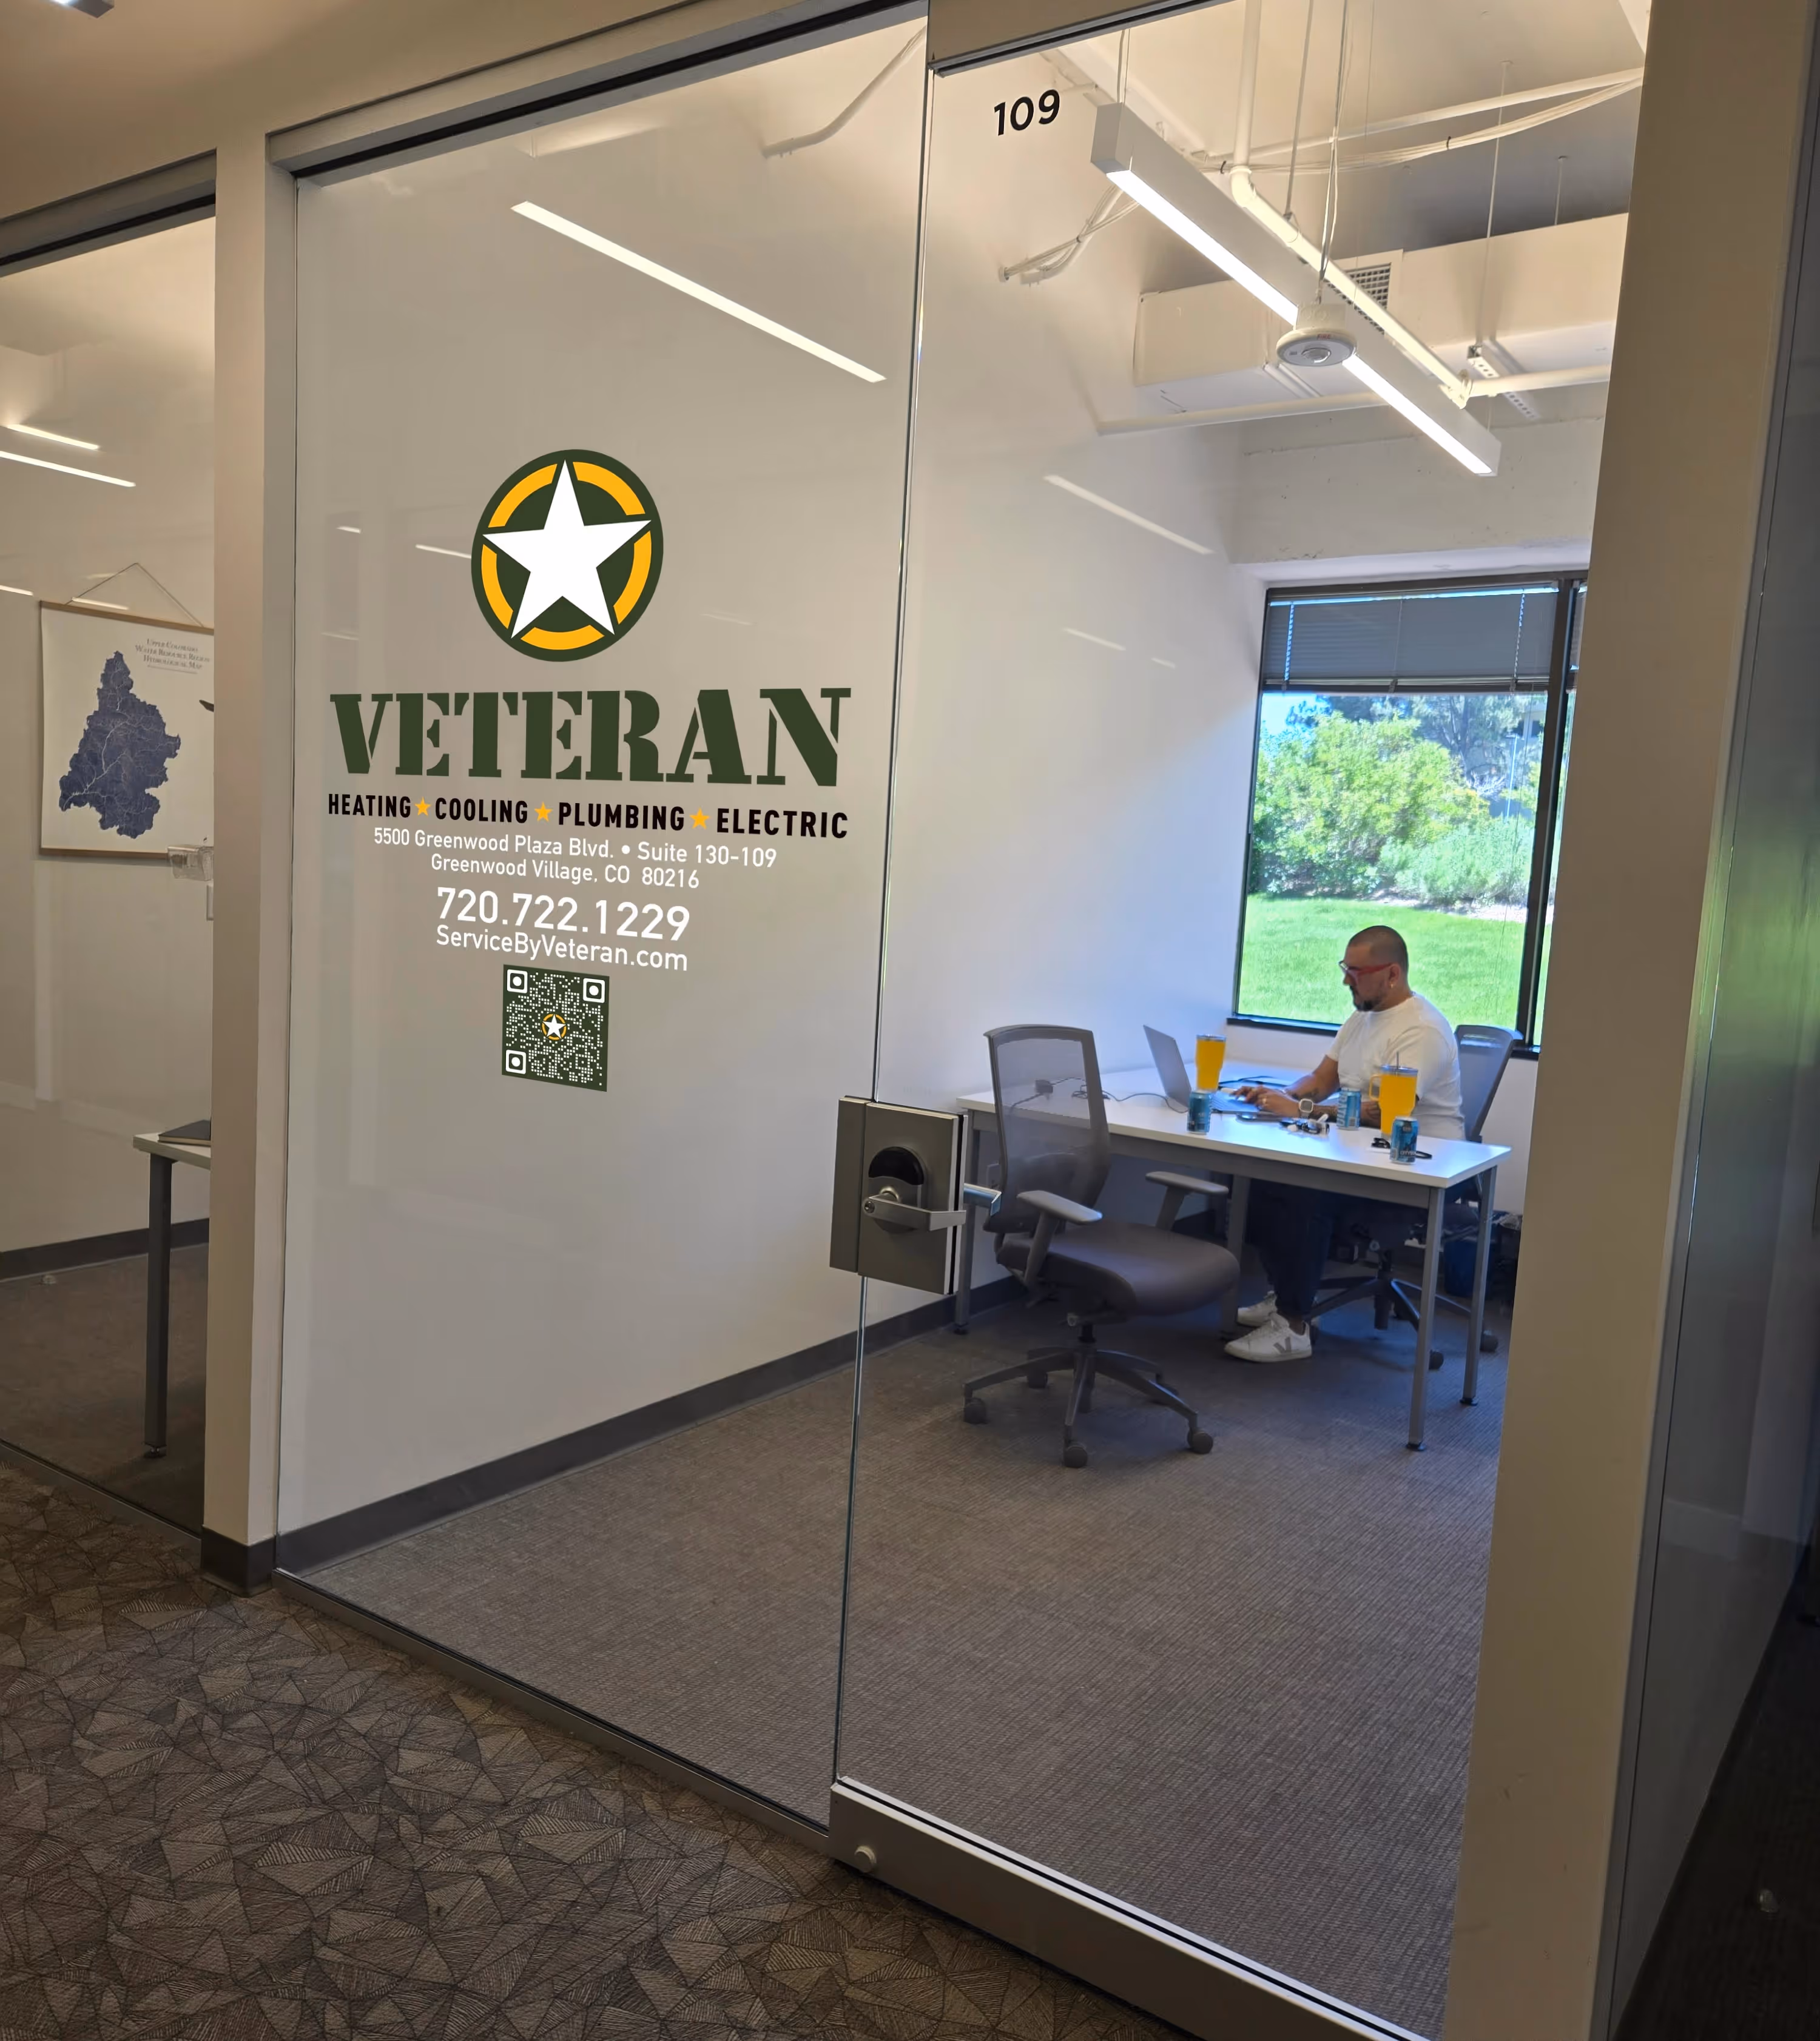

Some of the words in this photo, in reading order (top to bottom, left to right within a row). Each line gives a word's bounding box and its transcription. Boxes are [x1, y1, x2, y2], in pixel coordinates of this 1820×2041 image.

[994, 89, 1060, 136] 109
[330, 688, 851, 787] VETERAN
[328, 793, 412, 818] HEATING
[435, 797, 528, 824] COOLING
[558, 801, 685, 832] PLUMBING
[716, 808, 848, 839] ELECTRIC
[374, 827, 410, 846] 5500
[415, 829, 508, 852] Greenwood
[515, 835, 562, 855] Plaza
[569, 838, 614, 859] Blvd.
[637, 841, 687, 862] Suite
[695, 844, 777, 868] 130-109
[431, 853, 527, 876] Greenwood
[532, 859, 598, 885] Village,
[605, 864, 630, 884] CO
[641, 867, 699, 889] 80216
[437, 887, 690, 941] 720.722.1229
[436, 924, 687, 971] ServiceByVeteran.com
